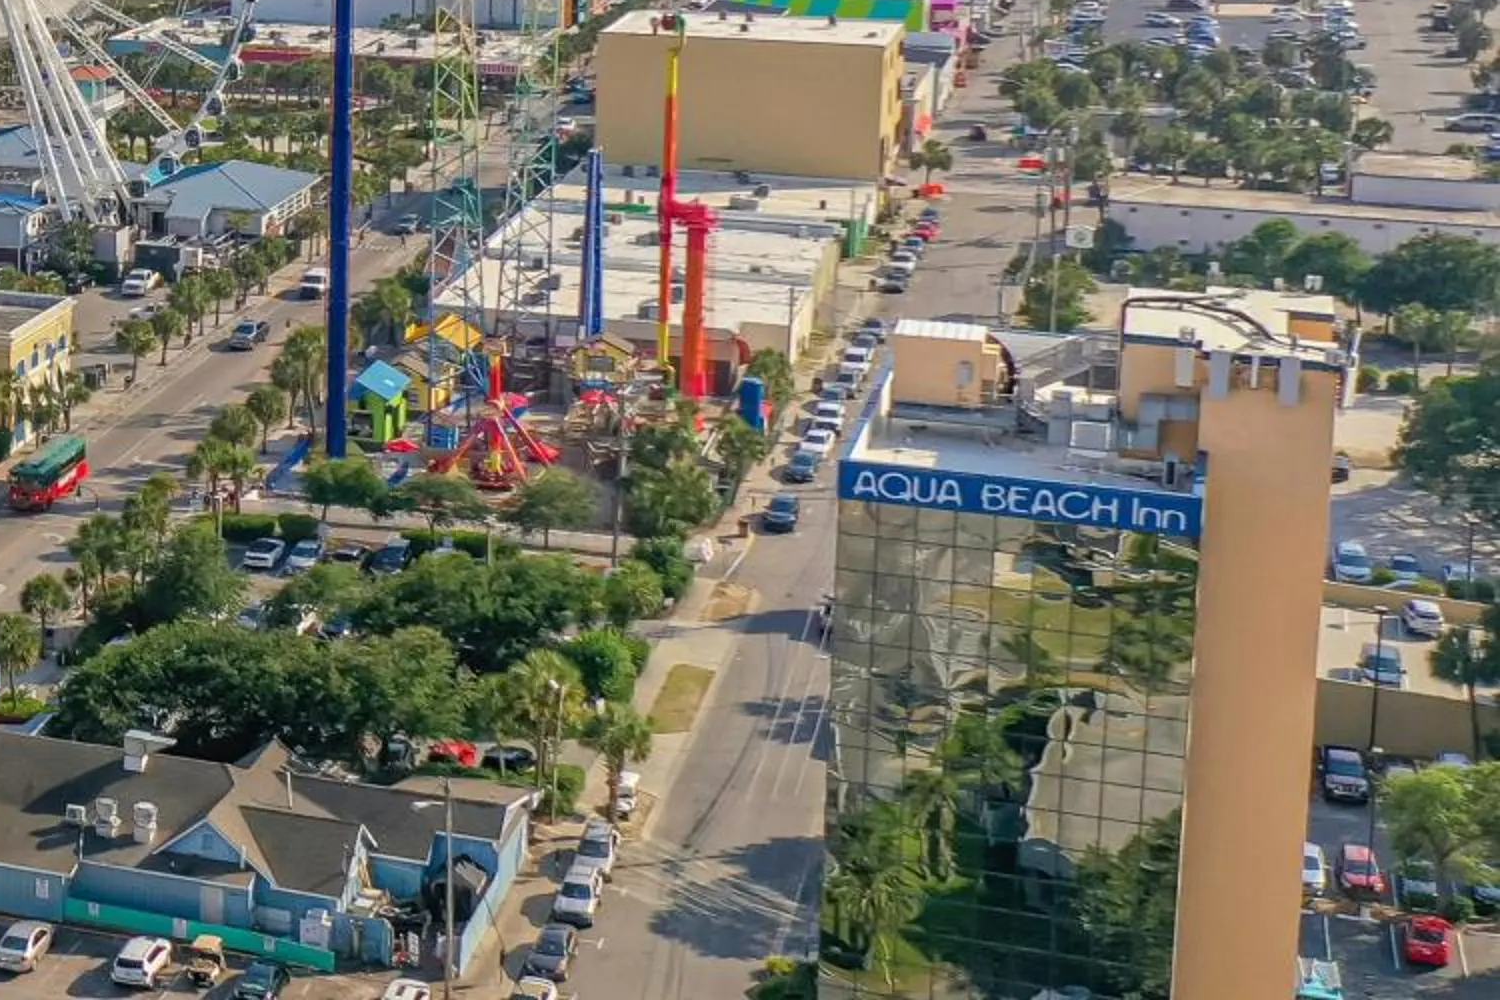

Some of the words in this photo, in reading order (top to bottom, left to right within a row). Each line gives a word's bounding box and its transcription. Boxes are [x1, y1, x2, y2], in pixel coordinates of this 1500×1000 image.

[852, 470, 963, 507] AQUA
[980, 483, 1120, 524] BEACH
[1130, 497, 1188, 532] Inn
